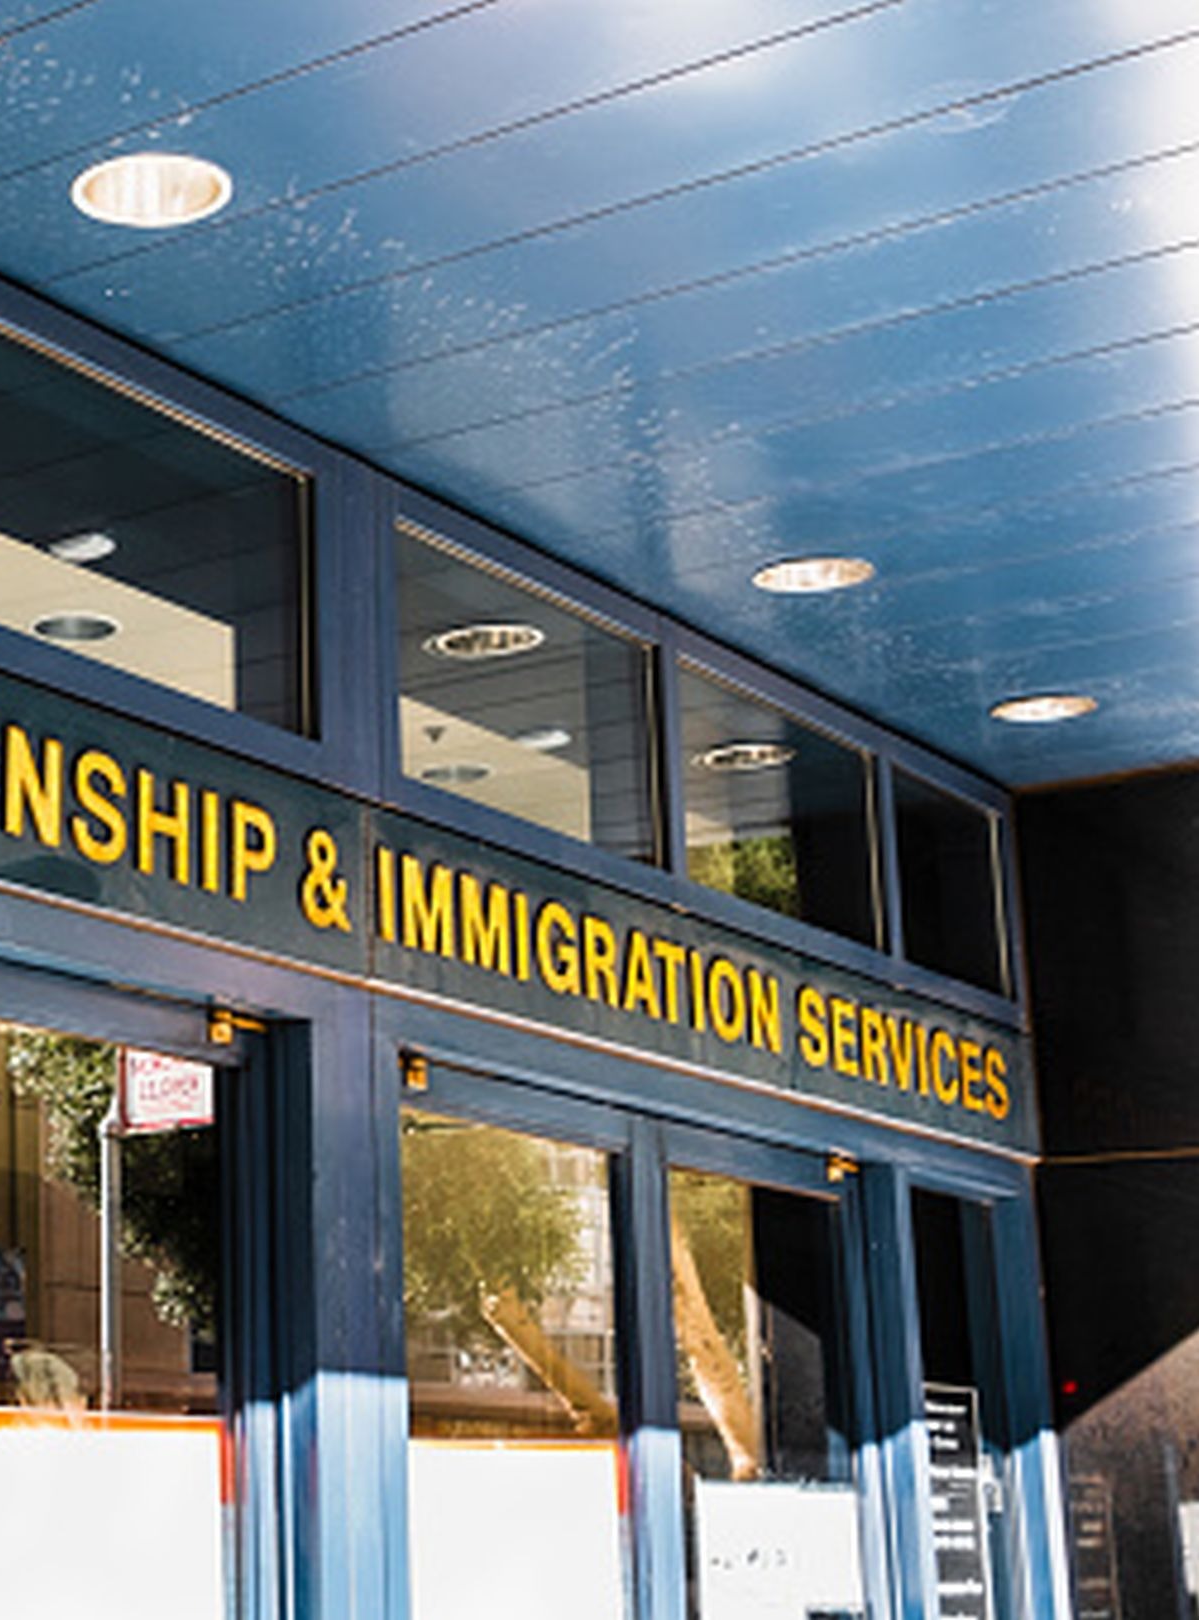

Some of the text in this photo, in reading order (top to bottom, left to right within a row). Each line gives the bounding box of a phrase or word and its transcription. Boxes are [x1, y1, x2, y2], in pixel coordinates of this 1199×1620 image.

[299, 828, 352, 933] &
[376, 847, 783, 1053] IMMIGRATION
[796, 986, 1011, 1120] SERVICES
